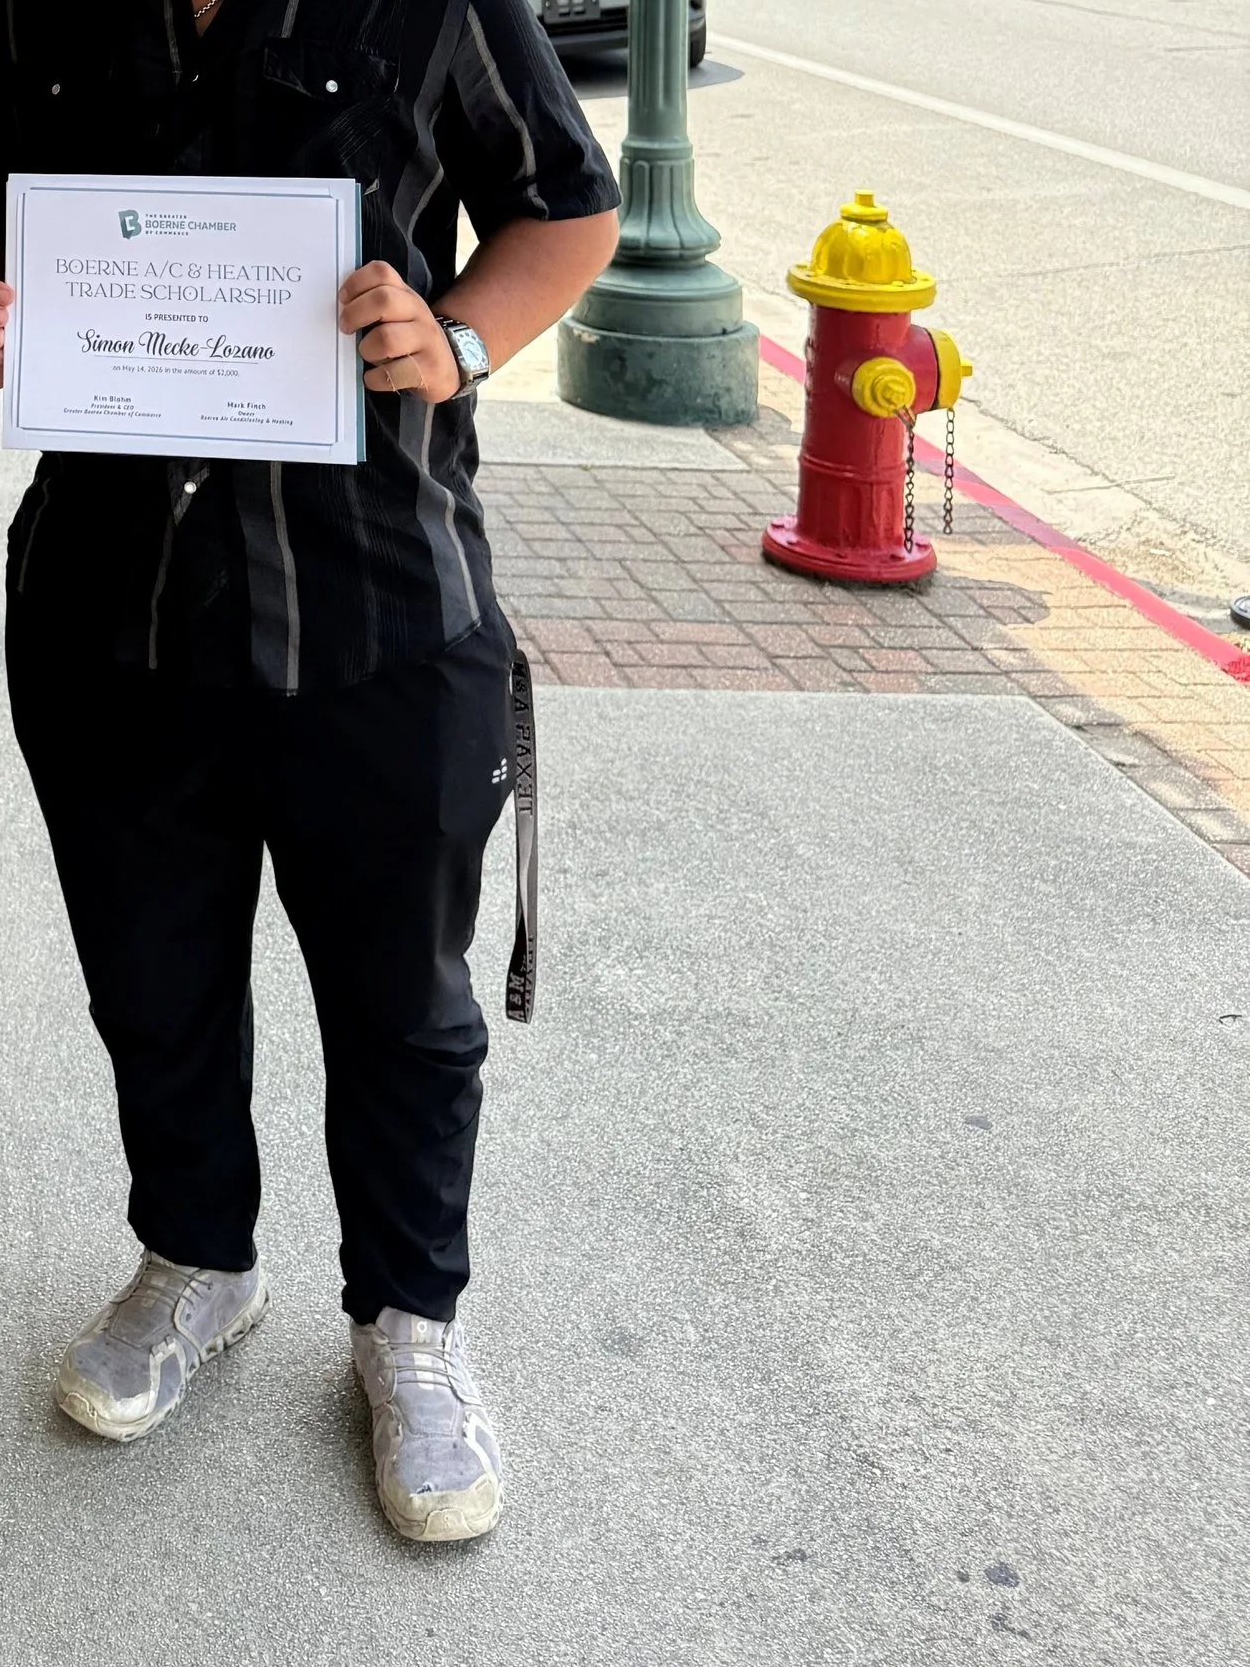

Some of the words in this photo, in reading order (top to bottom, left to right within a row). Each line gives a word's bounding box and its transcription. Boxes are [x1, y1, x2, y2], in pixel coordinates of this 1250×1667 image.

[145, 219, 186, 230] BOERNE
[187, 221, 237, 232] CHAMBER
[56, 258, 139, 277] BOERNE
[144, 259, 183, 279] A/C
[187, 262, 202, 279] &
[207, 263, 302, 283] HEATING
[65, 281, 136, 299] TRADE
[140, 283, 292, 305] SCHOLARSHIP
[145, 313, 152, 321] IS
[153, 314, 197, 323] PRESENTED
[198, 315, 209, 323] TO
[77, 328, 135, 354] Simon
[138, 330, 276, 360] Mecke-Lozano
